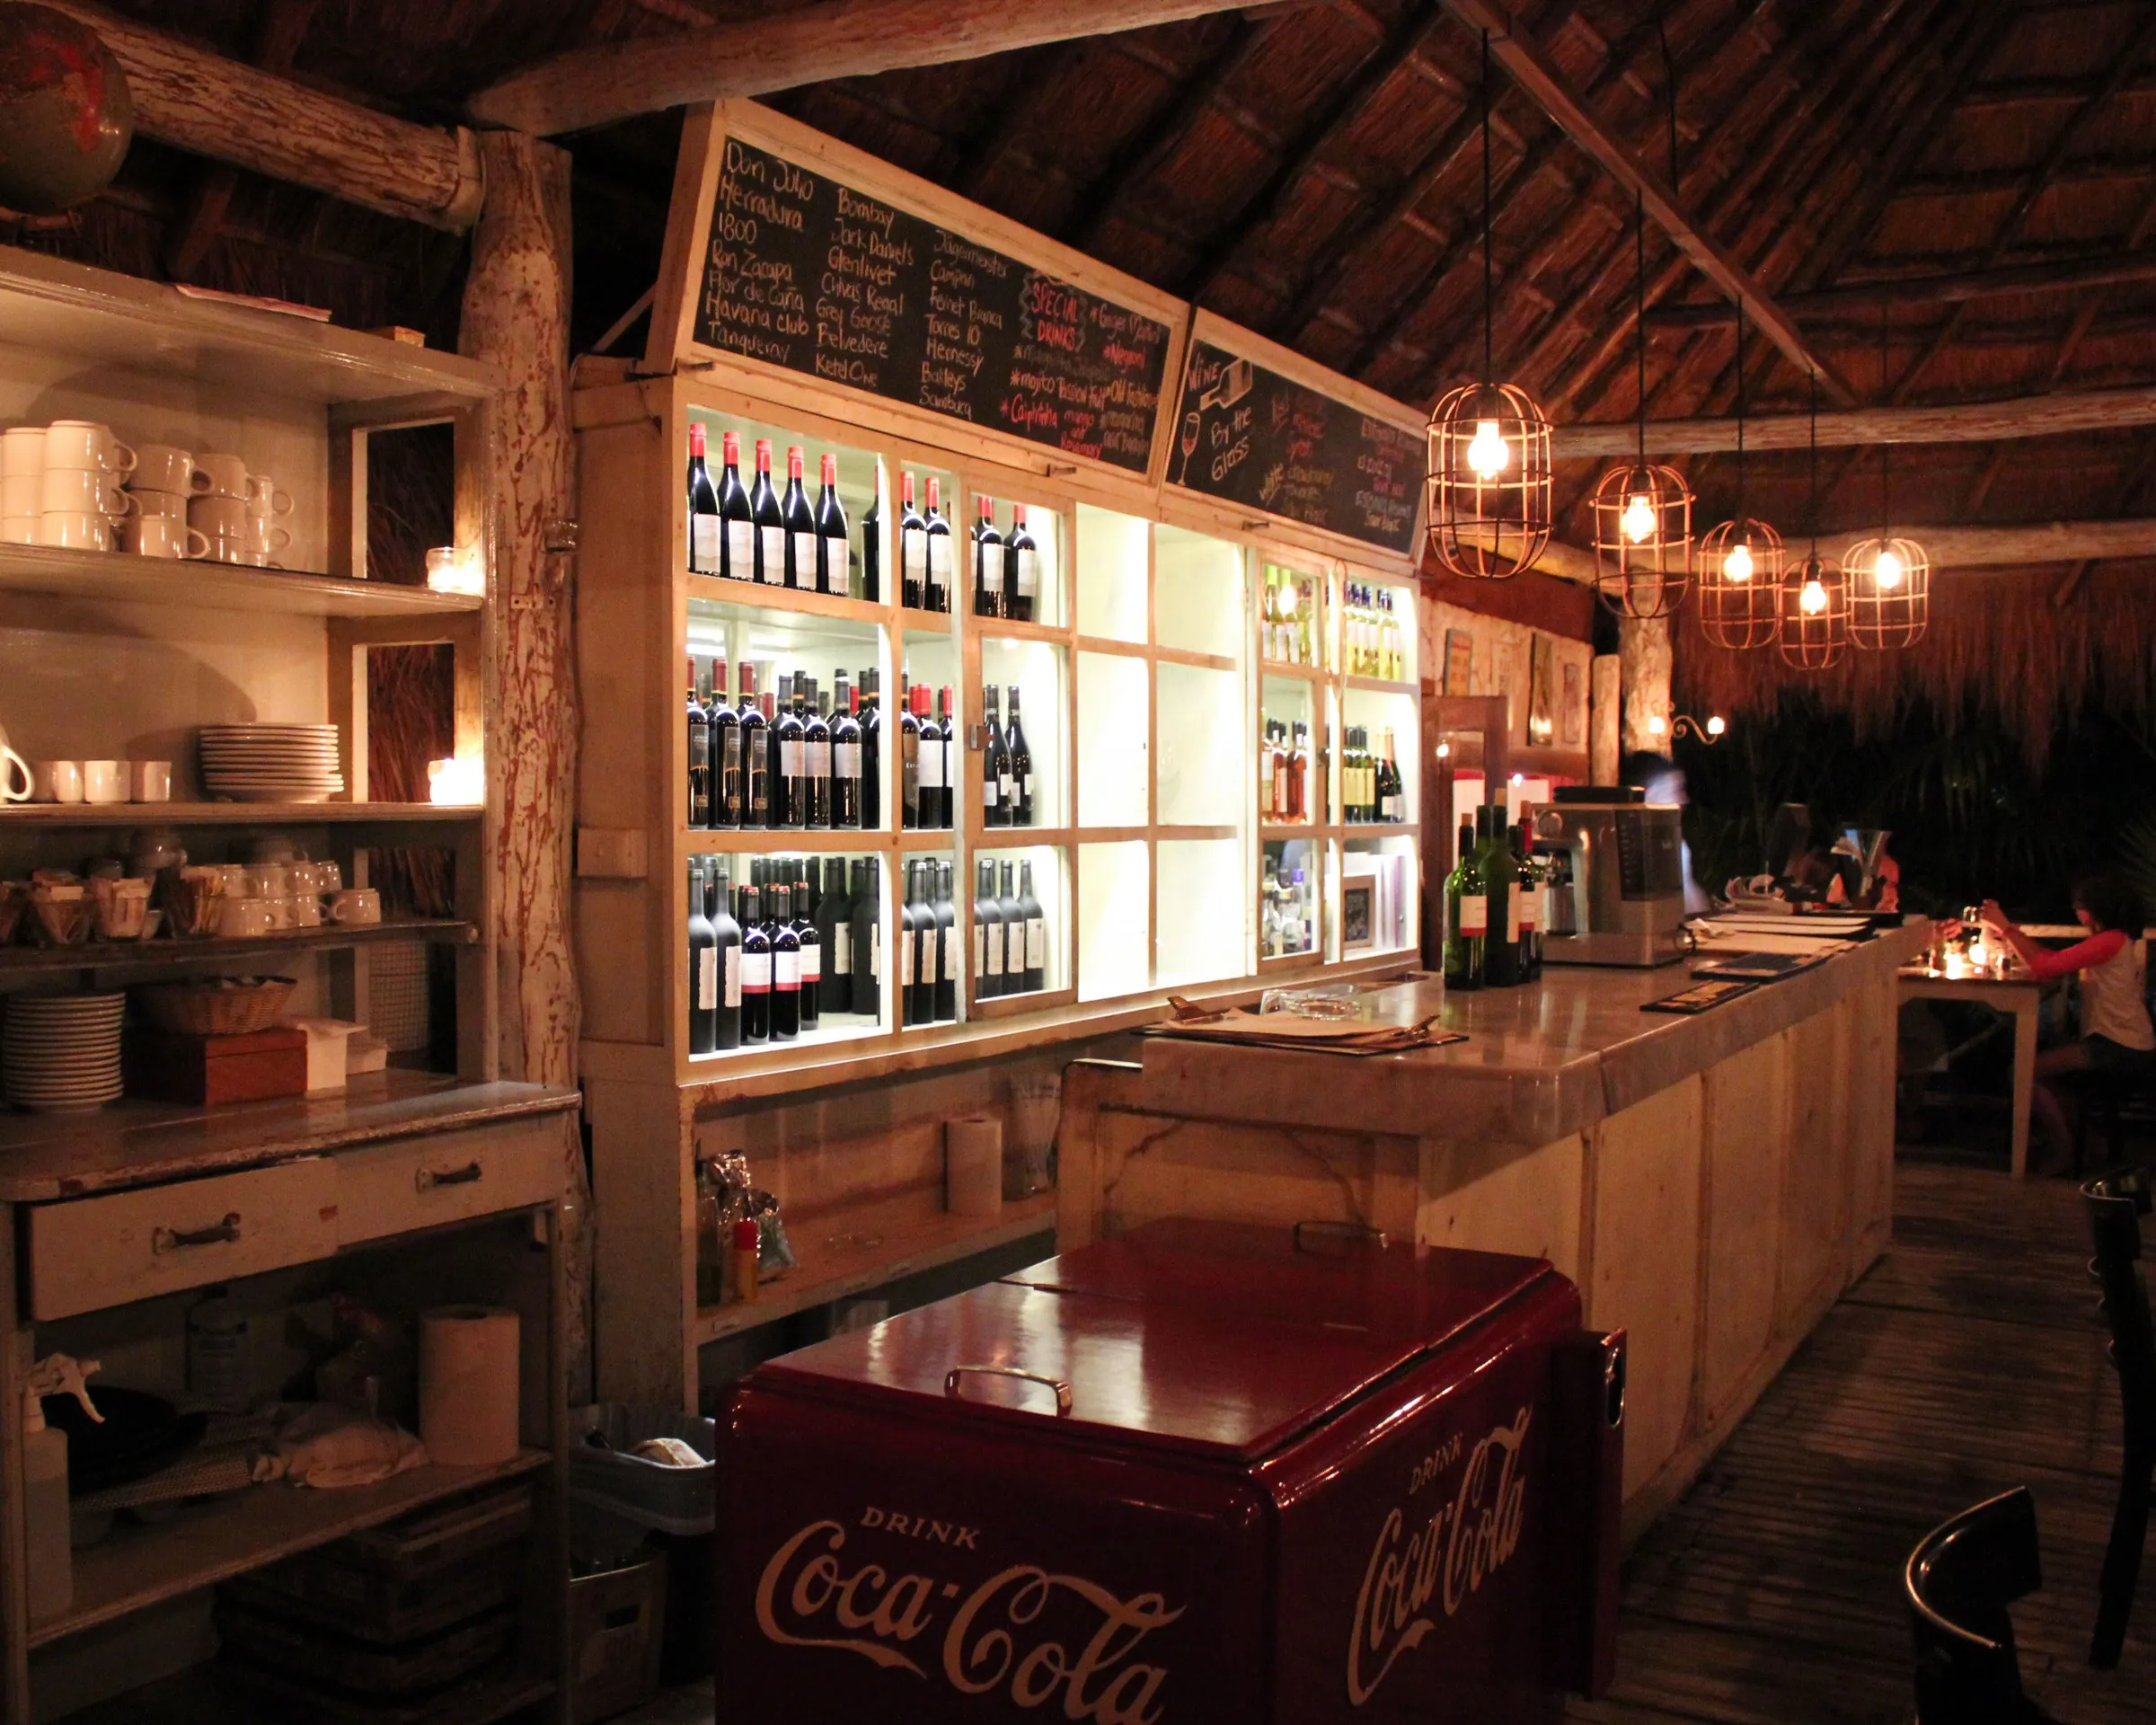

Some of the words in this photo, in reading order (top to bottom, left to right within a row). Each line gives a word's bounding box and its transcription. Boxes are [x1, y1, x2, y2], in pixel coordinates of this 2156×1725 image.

[727, 142, 764, 182] Don
[773, 159, 814, 201] Julio
[720, 175, 804, 232] Herradura
[838, 187, 895, 239] Bombay
[719, 213, 757, 245] 1800
[831, 217, 867, 249] Jack
[870, 231, 915, 267] Daniels
[711, 239, 738, 269] Ron
[741, 250, 792, 285] Zacapa
[828, 245, 897, 286] Glenlivet
[706, 291, 771, 330] Havana
[709, 270, 738, 296] Flor
[745, 285, 764, 303] de
[768, 287, 804, 314] Caña
[867, 285, 904, 316] Regal
[930, 286, 966, 317] Fernet
[1030, 281, 1078, 324] SPECIAL
[816, 297, 843, 333] Grey
[851, 306, 890, 334] Goose
[924, 314, 960, 341] Torres
[967, 325, 980, 346] 10
[1038, 319, 1075, 351] DRINKS
[708, 321, 791, 363] Tanqueray
[817, 322, 888, 359] Belvedere
[816, 353, 847, 380] Ketel
[1211, 421, 1229, 448] By
[1408, 1431, 1462, 1496] DRINK
[861, 1506, 982, 1551] DRINK
[1347, 1403, 1533, 1708] Coca-Cola
[755, 1520, 1188, 1725] Coca-Cola
